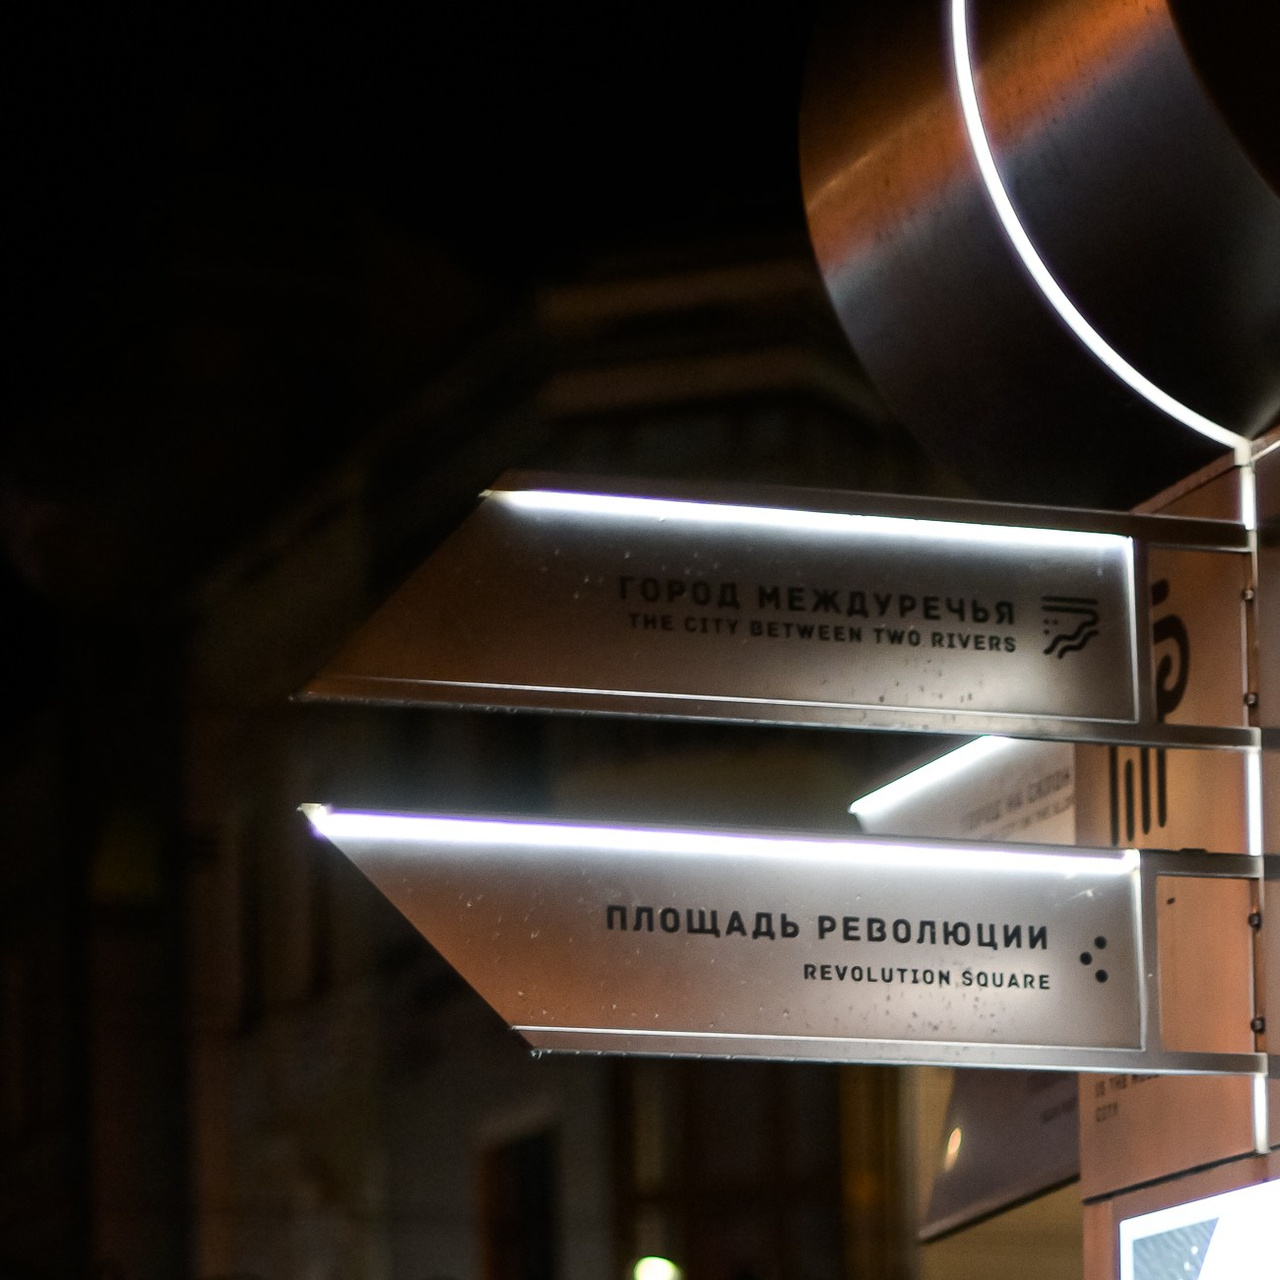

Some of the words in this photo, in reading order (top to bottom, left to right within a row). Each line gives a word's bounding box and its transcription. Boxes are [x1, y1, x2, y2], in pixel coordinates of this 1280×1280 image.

[617, 575, 741, 610] ГОРОД
[757, 585, 1015, 626] МЕЖДУРЕЧЬЯ
[629, 611, 674, 632] THE
[684, 616, 739, 636] CITY
[750, 619, 863, 643] BETWEEN
[873, 626, 922, 648] TWO
[930, 631, 1018, 653] RIVERS
[605, 903, 801, 940] ПЛОЩАДЬ
[817, 914, 1050, 951] РЕВОЛЮЦИИ
[803, 962, 951, 987] REVOLUTION
[961, 968, 1051, 991] SQUARE
